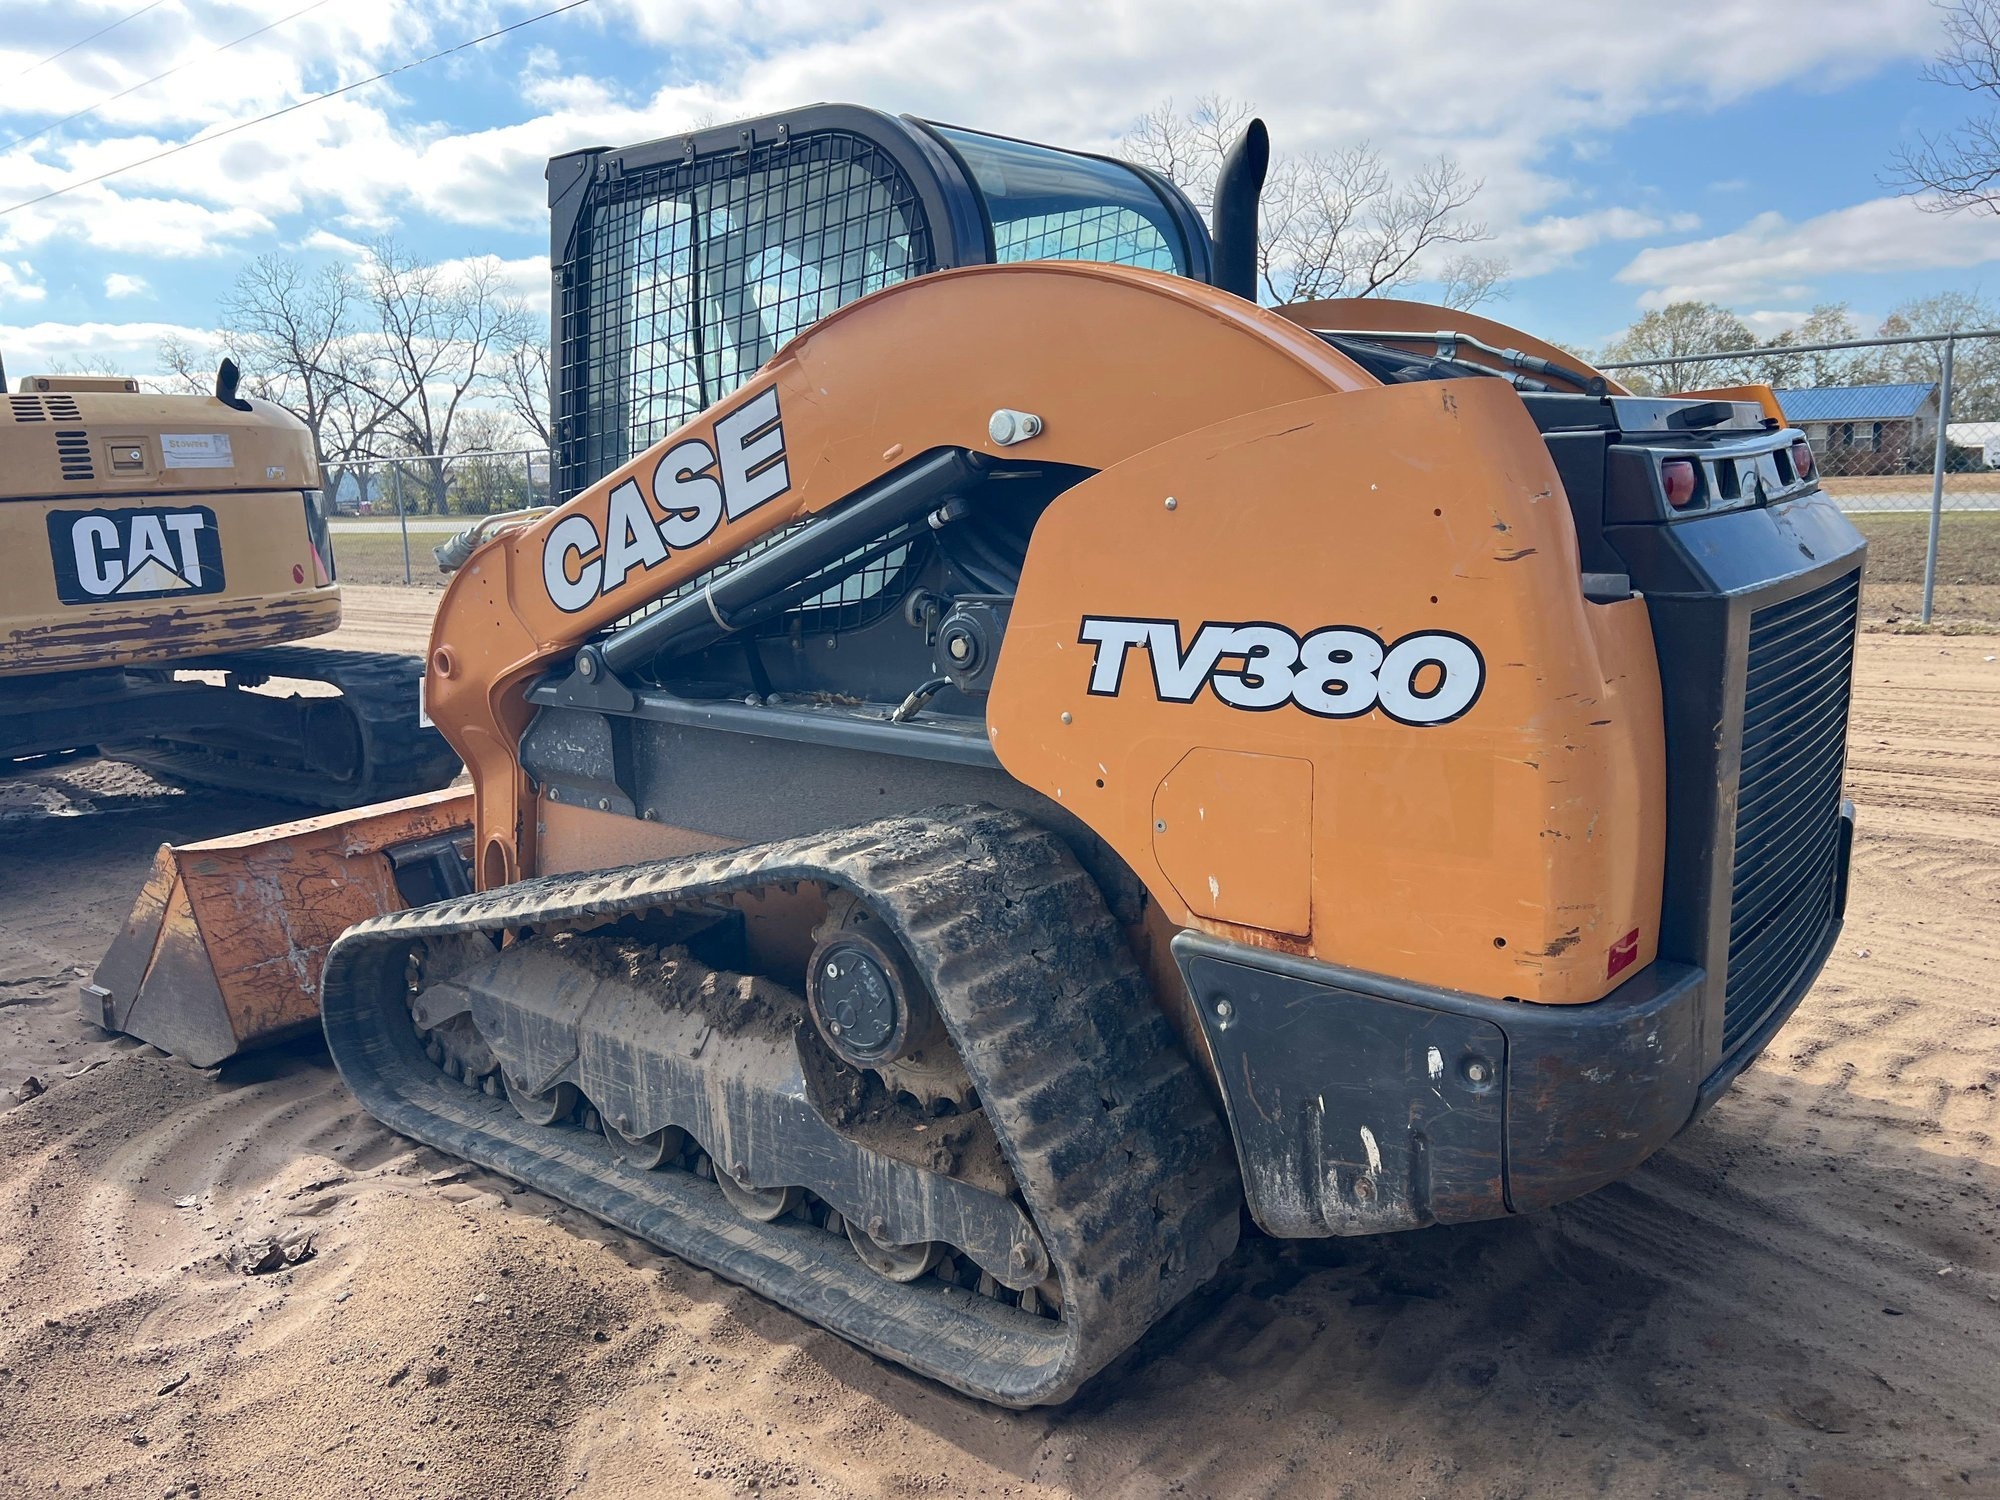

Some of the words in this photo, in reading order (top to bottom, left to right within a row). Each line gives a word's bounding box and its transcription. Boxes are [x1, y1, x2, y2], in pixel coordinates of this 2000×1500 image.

[71, 513, 204, 595] CAT
[543, 383, 791, 613] CASE
[1077, 615, 1486, 728] TV380
